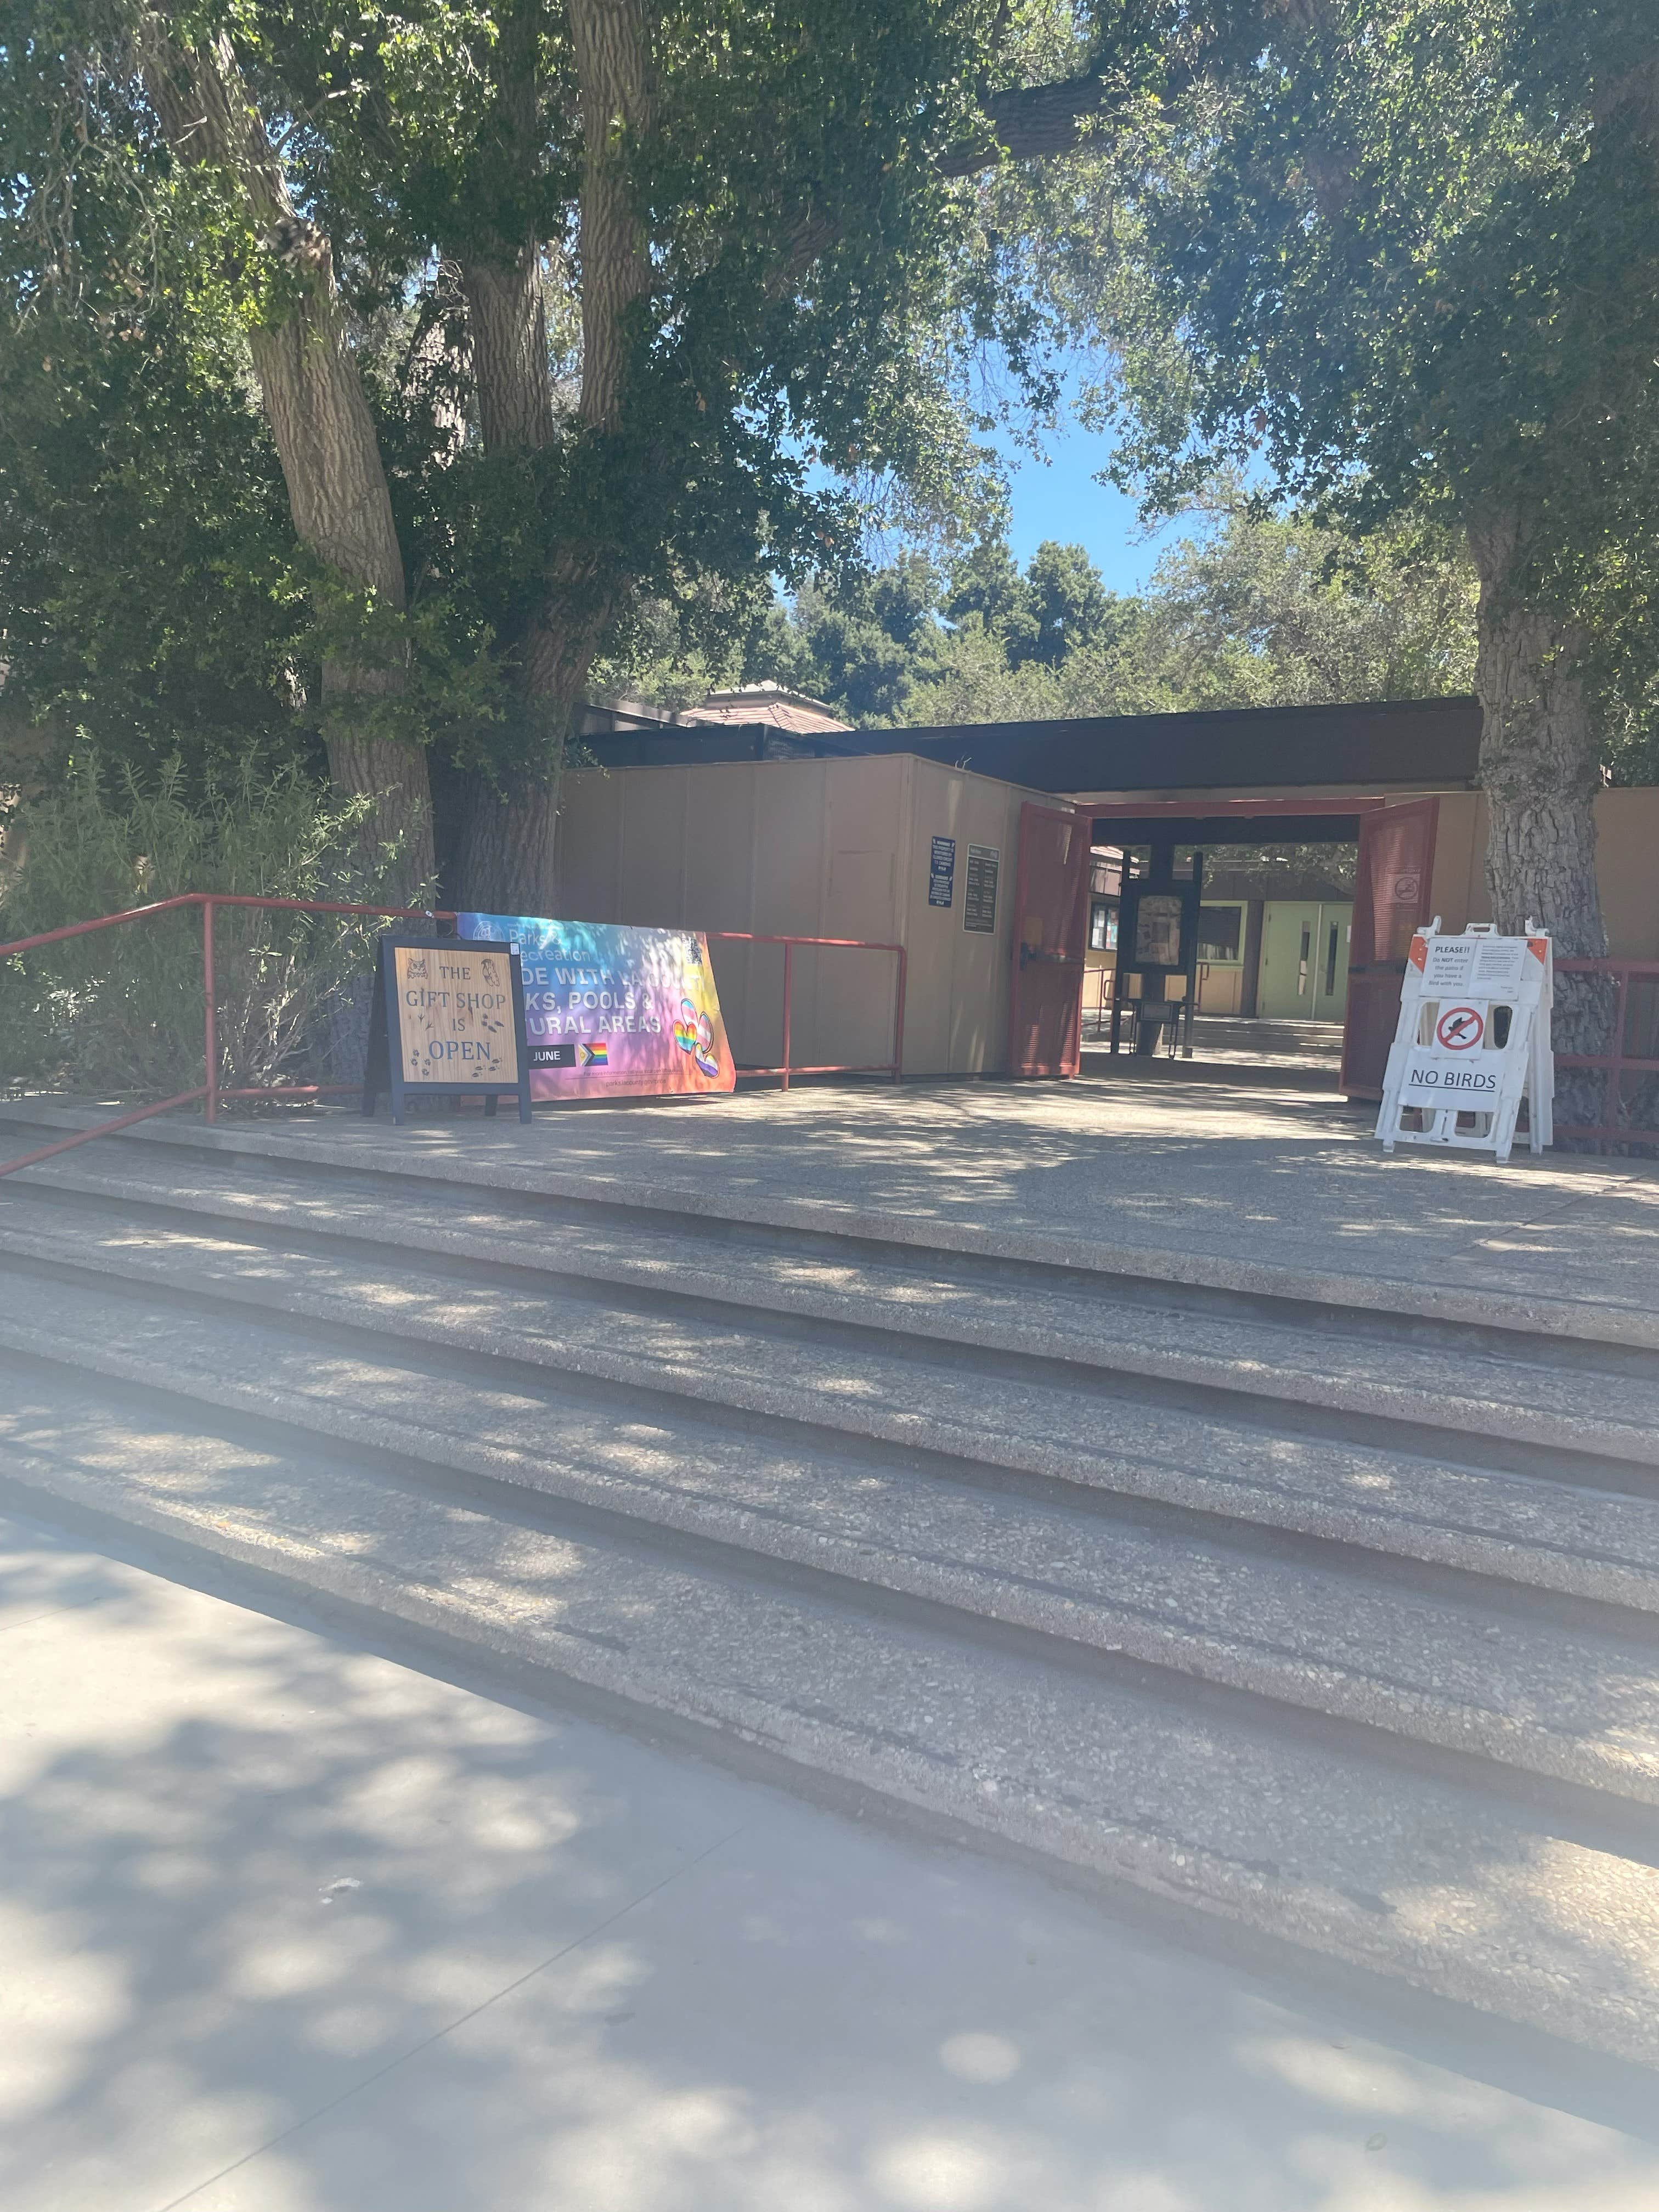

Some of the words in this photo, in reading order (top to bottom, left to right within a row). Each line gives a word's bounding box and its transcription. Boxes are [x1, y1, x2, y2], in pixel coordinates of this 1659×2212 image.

[509, 928, 545, 945] Parks
[551, 932, 562, 945] &
[521, 949, 591, 962] ecreation
[439, 966, 471, 980] THE
[522, 967, 549, 985] DE
[555, 967, 615, 986] WITH
[618, 970, 644, 987] LA
[406, 990, 450, 1008] GIFT
[456, 992, 506, 1009] SHOP
[525, 992, 561, 1014] KS,
[568, 991, 636, 1010] POOLS
[642, 992, 654, 1010] &
[453, 1018, 465, 1031] IS
[528, 1015, 591, 1036] URAL
[598, 1016, 662, 1034] AREAS
[428, 1040, 490, 1060] OPEN
[533, 1051, 561, 1062] JUNE
[1411, 1069, 1438, 1084] NO
[1444, 1072, 1497, 1089] BIRDS
